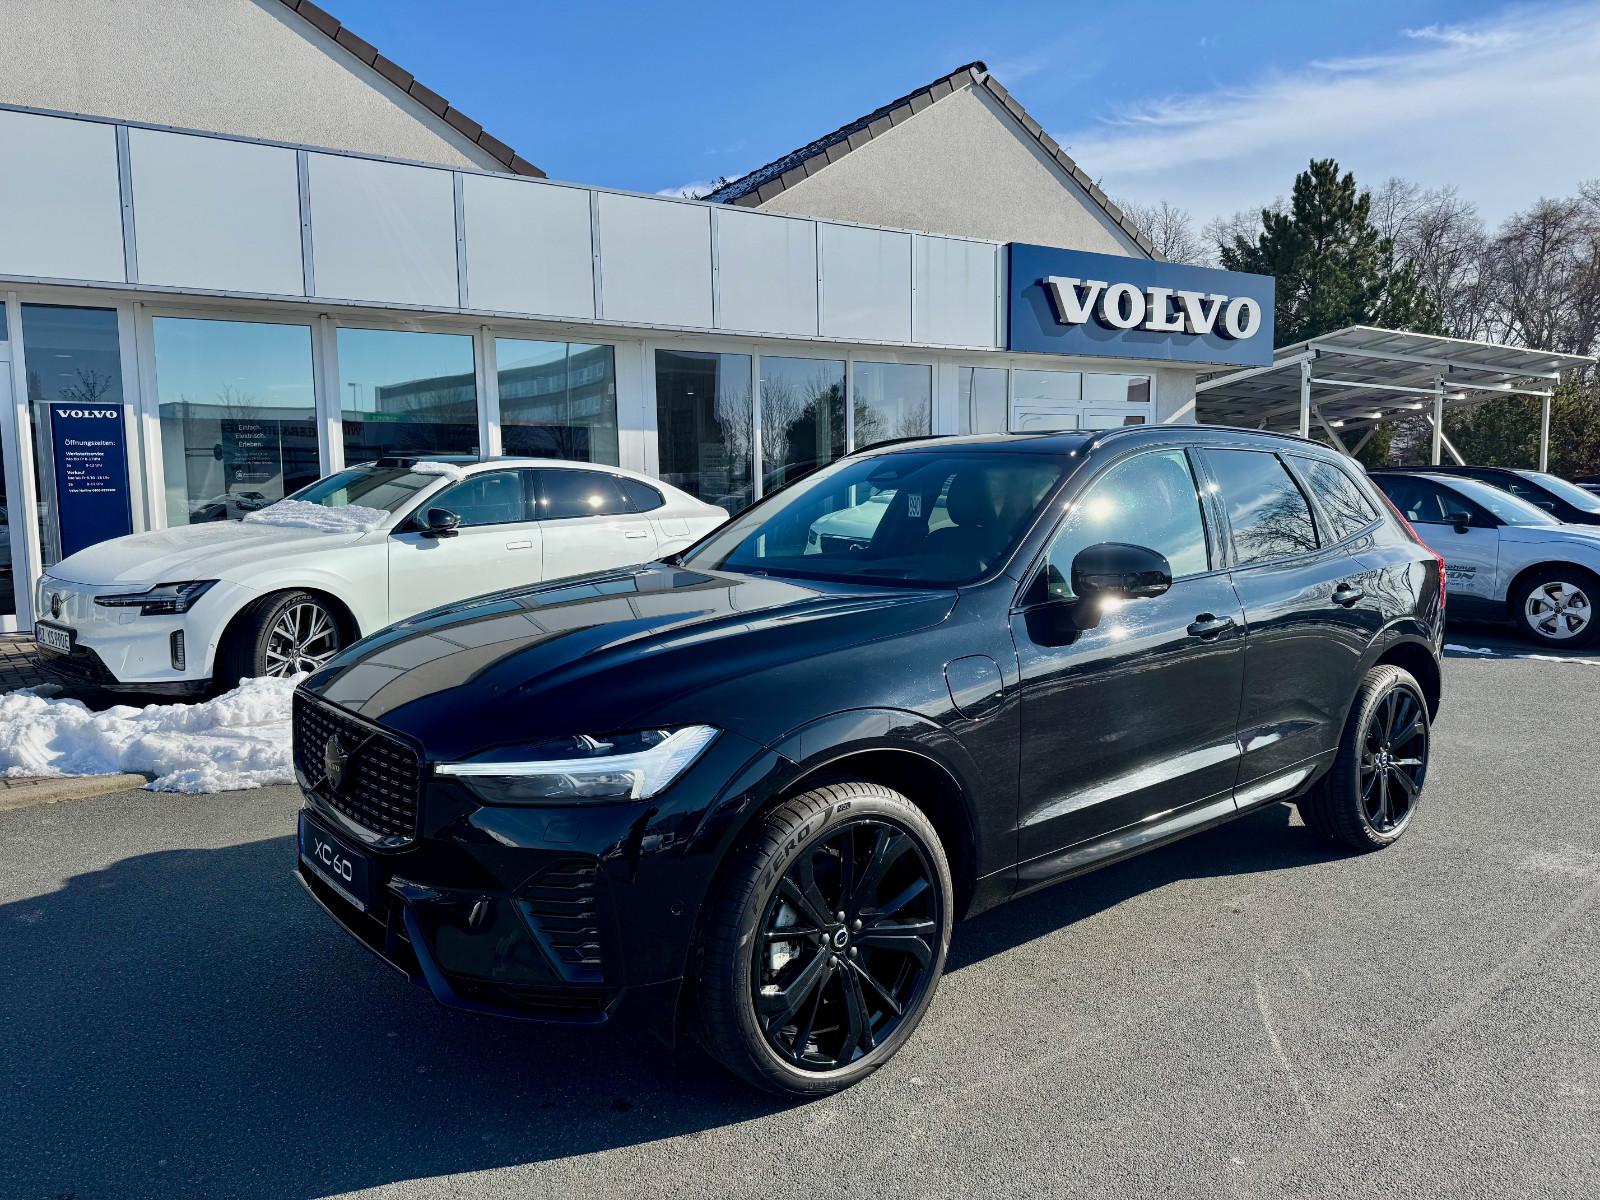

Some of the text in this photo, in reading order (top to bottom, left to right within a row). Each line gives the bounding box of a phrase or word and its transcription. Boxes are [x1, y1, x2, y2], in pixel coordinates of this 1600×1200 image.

[1046, 275, 1261, 340] VOLVO
[56, 409, 118, 419] VOLVO
[64, 438, 116, 447] Öffnungszeiten:
[761, 824, 811, 891] ZERO
